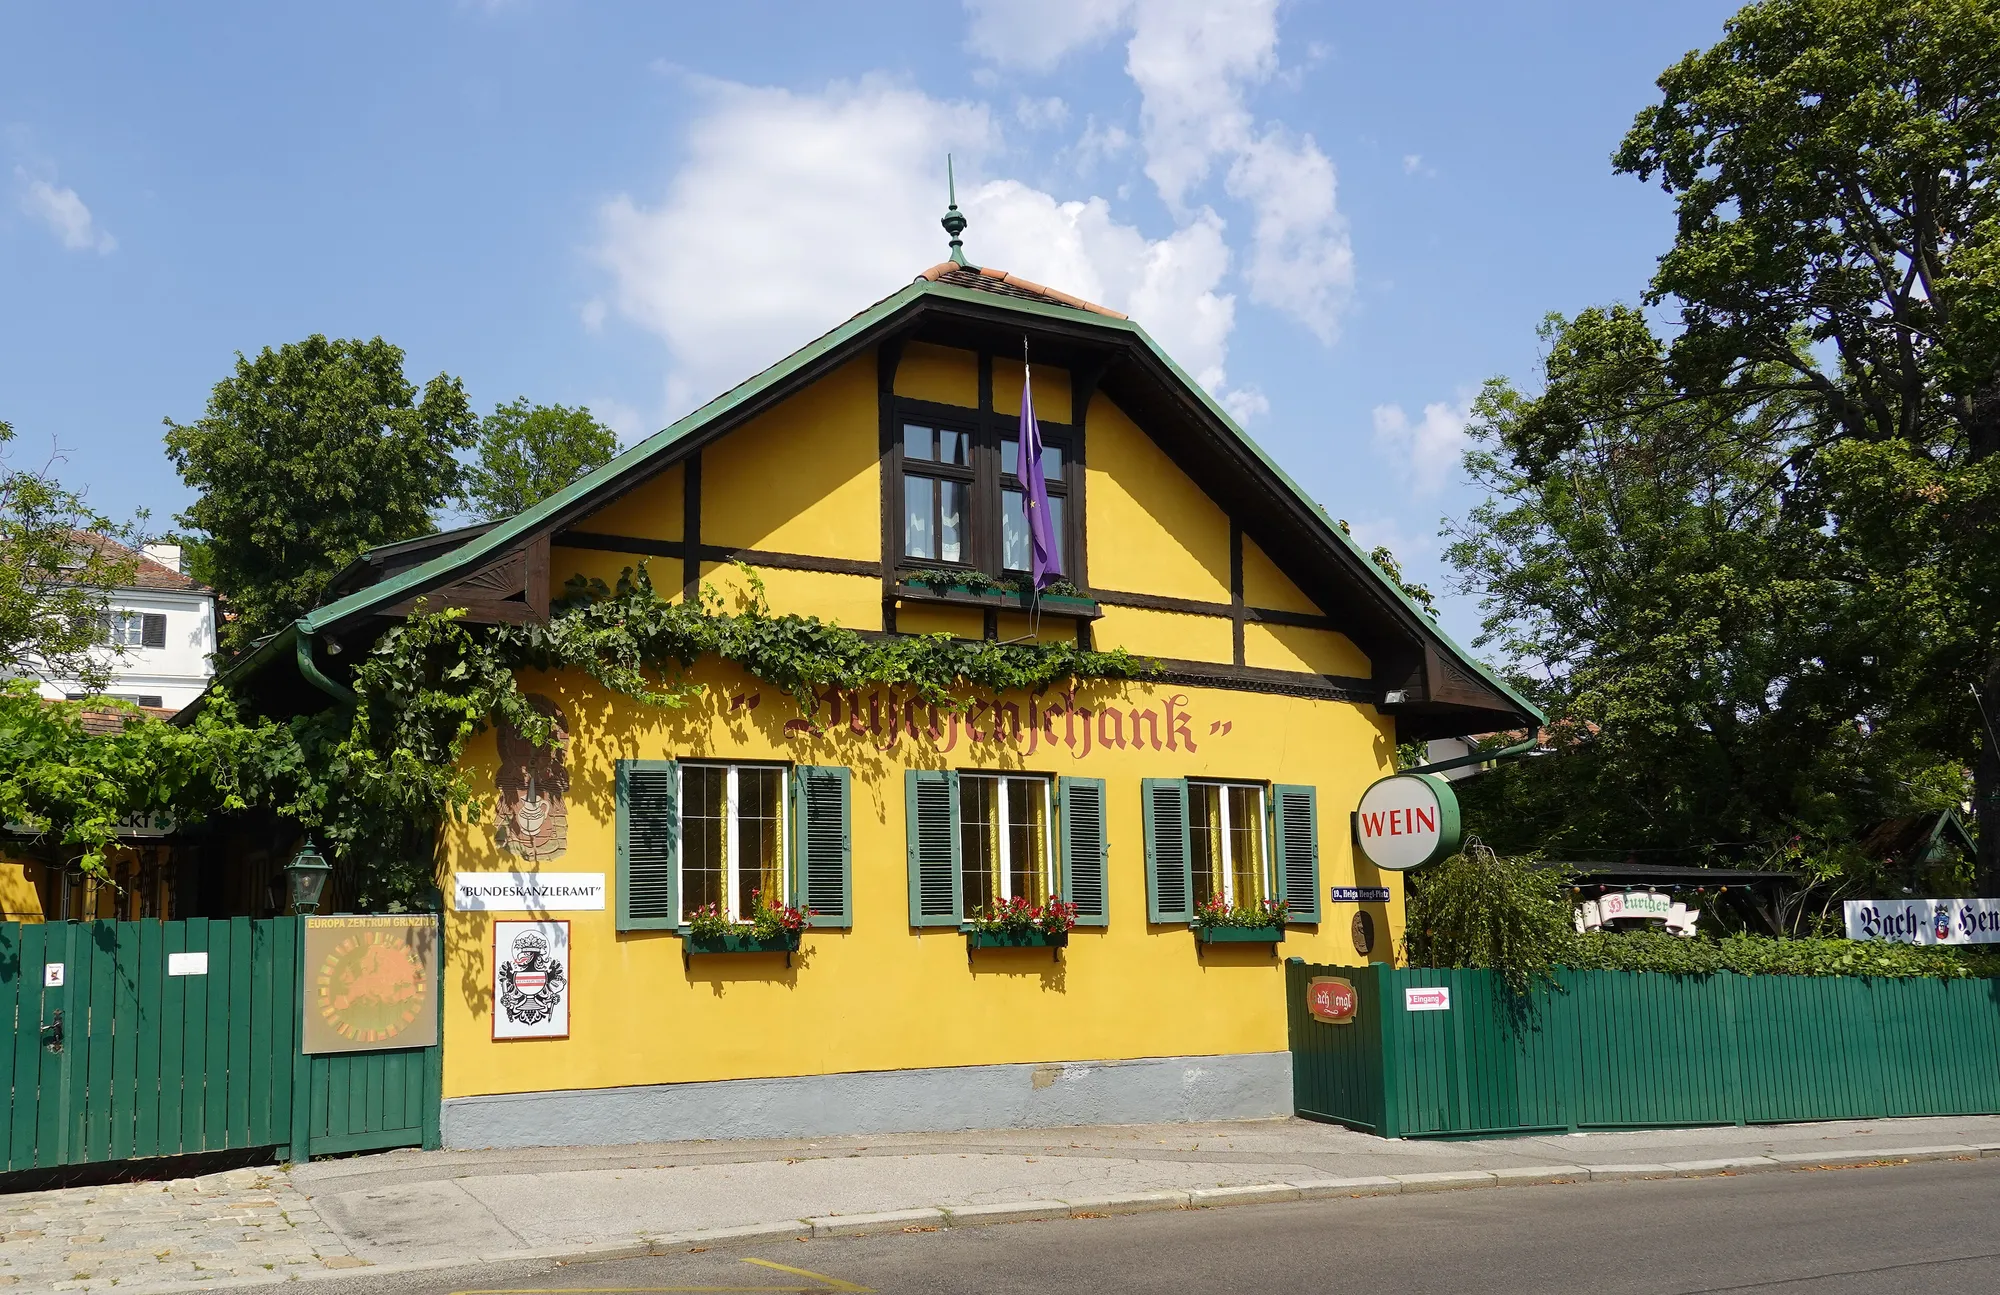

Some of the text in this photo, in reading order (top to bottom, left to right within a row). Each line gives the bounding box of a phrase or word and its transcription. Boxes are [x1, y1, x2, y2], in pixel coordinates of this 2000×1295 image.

[1361, 806, 1435, 838] WEIN
[1343, 889, 1359, 900] Helga
[1359, 889, 1389, 899] Hengl-Platz
[1608, 896, 1669, 914] Heuriger
[308, 916, 436, 929] EUROPA ZENTRUM GRINZING
[1413, 995, 1440, 1004] Eingang
